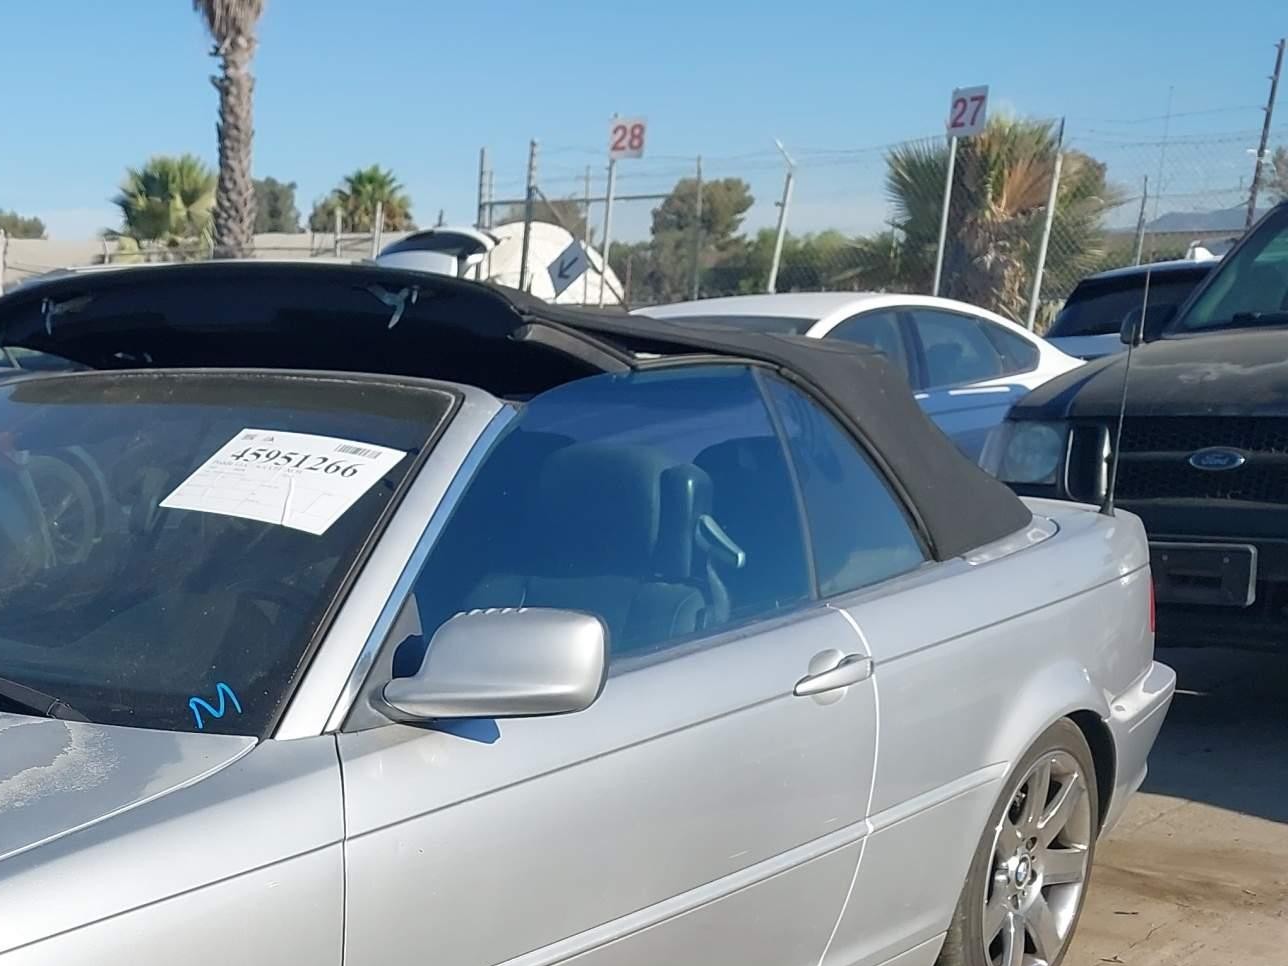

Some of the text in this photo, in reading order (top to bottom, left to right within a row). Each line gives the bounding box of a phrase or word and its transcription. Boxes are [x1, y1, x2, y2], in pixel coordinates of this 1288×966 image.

[951, 96, 986, 129] 27
[611, 123, 645, 152] 28
[231, 446, 365, 478] 45951266
[189, 682, 242, 729] M
